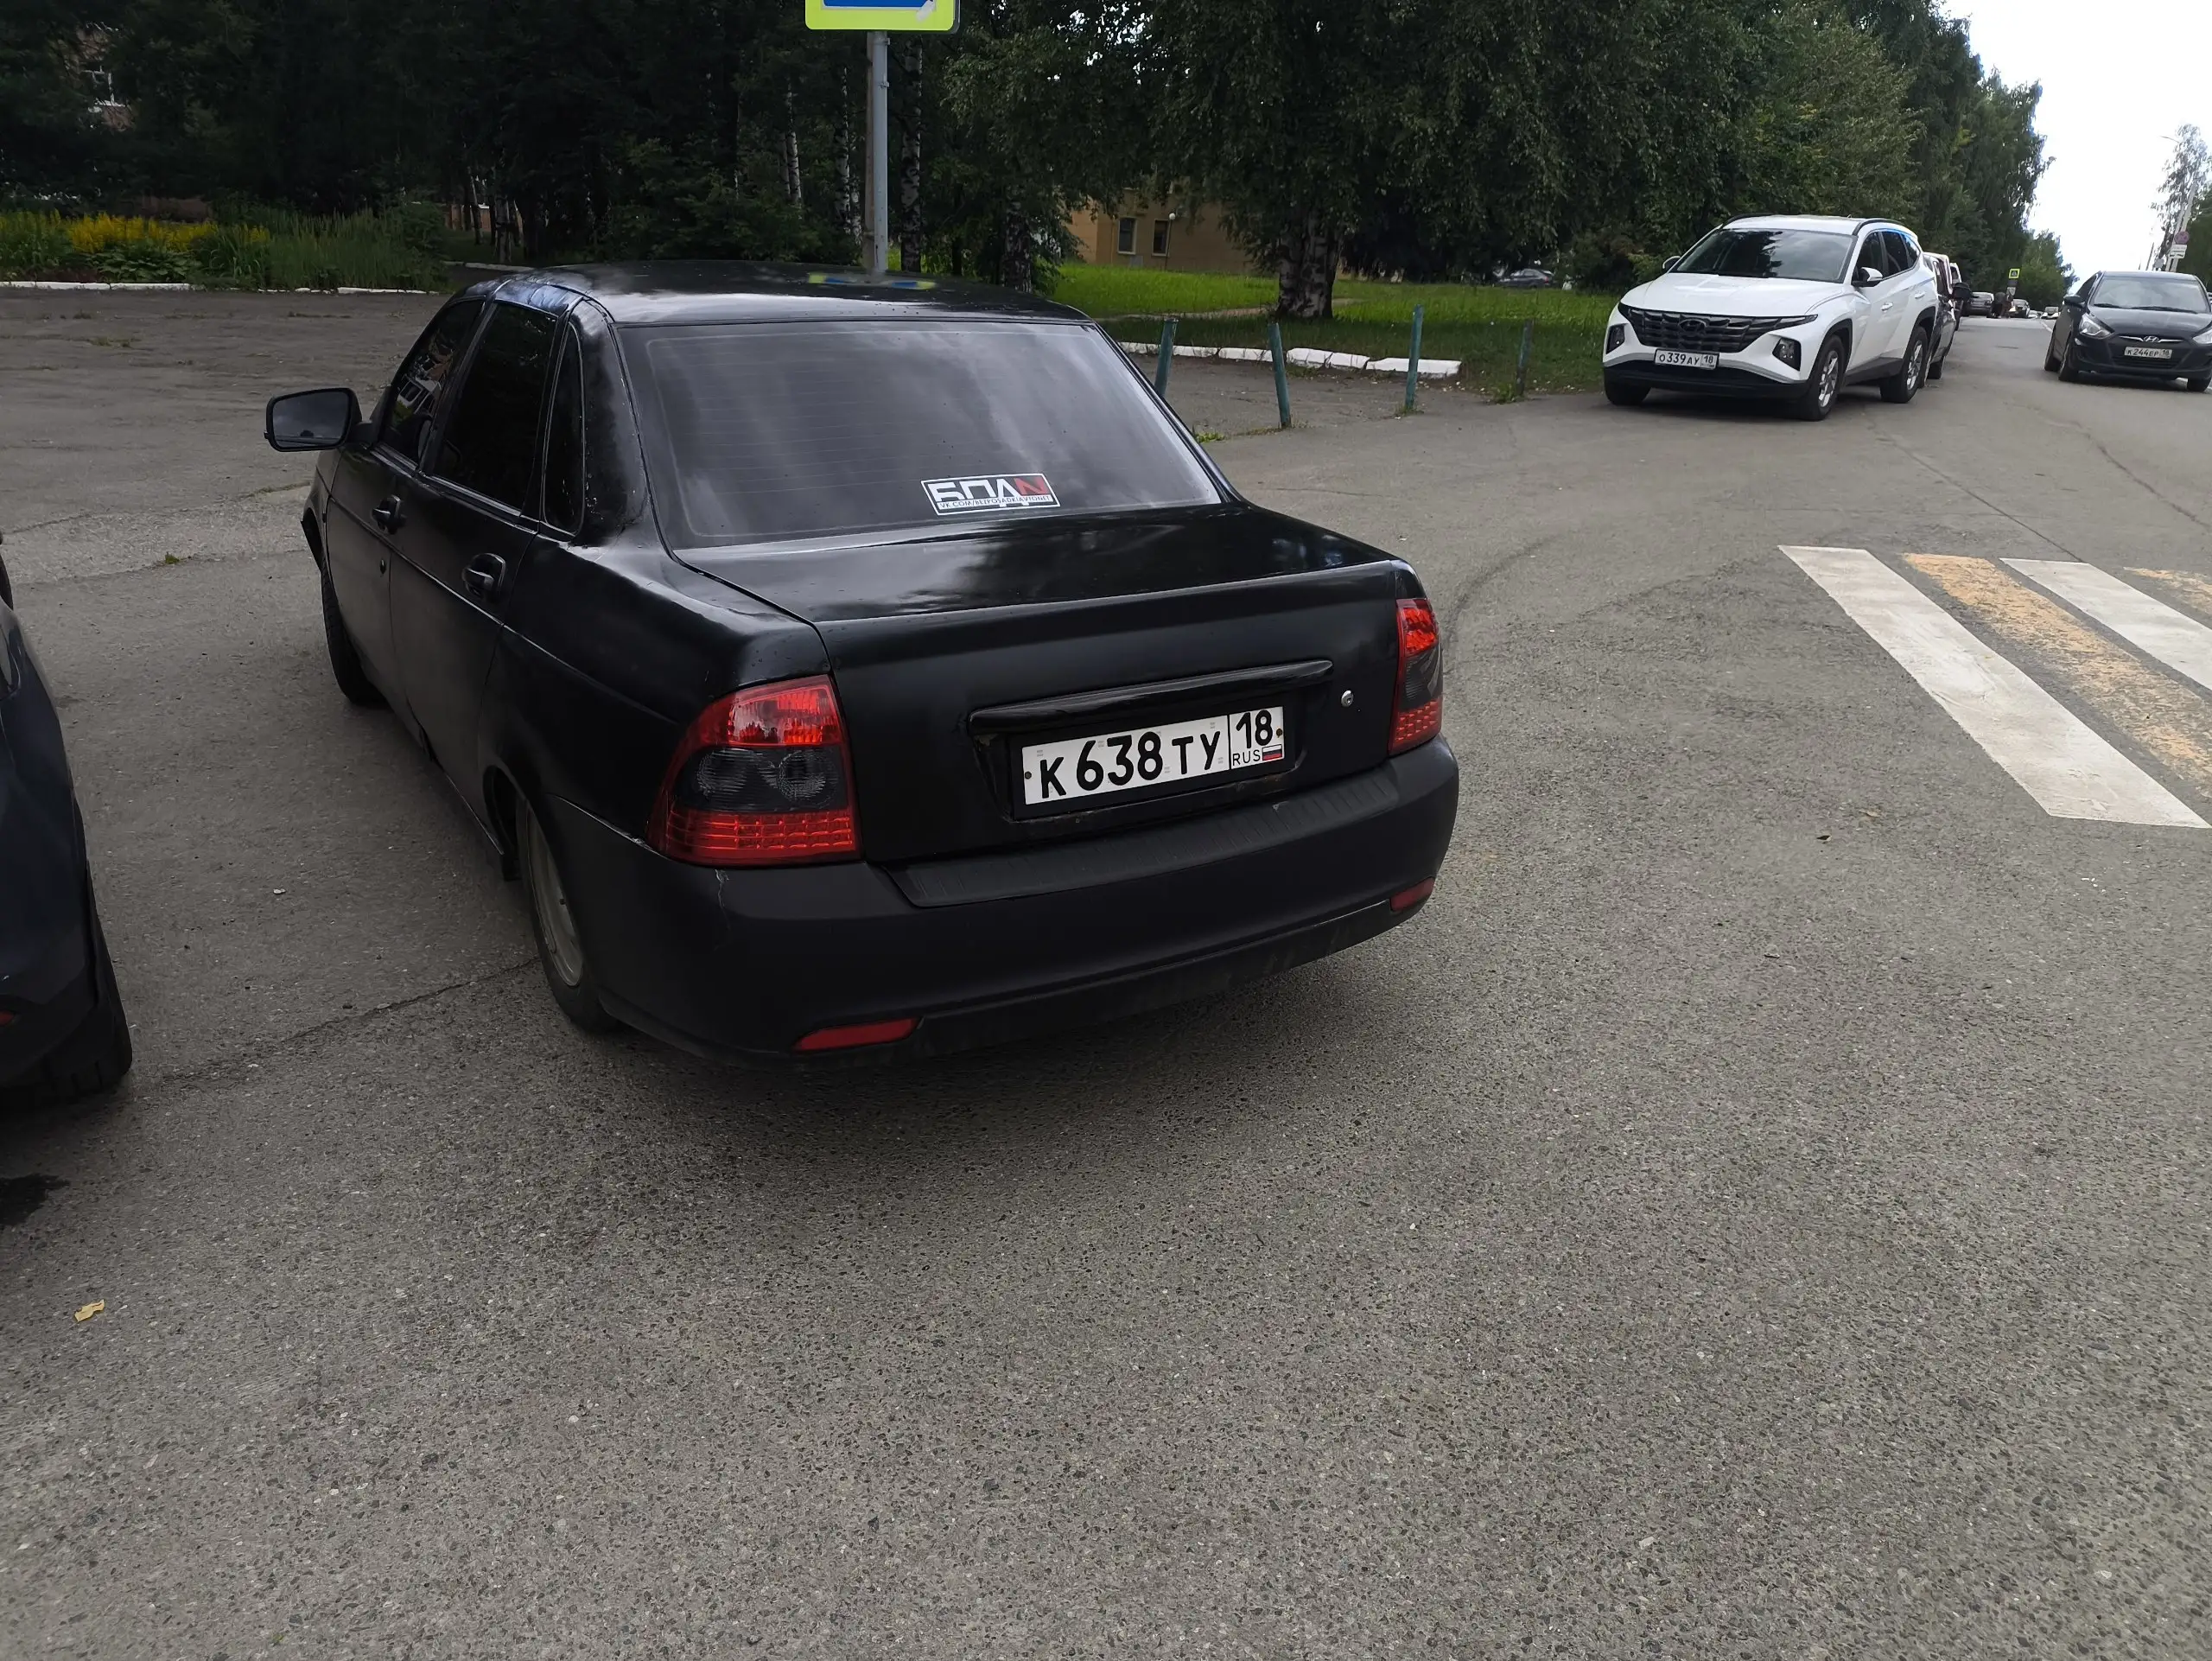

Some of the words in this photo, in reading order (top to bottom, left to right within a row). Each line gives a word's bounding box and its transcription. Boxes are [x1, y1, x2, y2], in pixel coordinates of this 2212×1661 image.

[1659, 353, 1700, 365] О339АУ
[1704, 355, 1713, 364] 18
[1039, 731, 1221, 799] К638ТУ
[1236, 709, 1274, 749] 18
[1232, 749, 1261, 767] RUS
